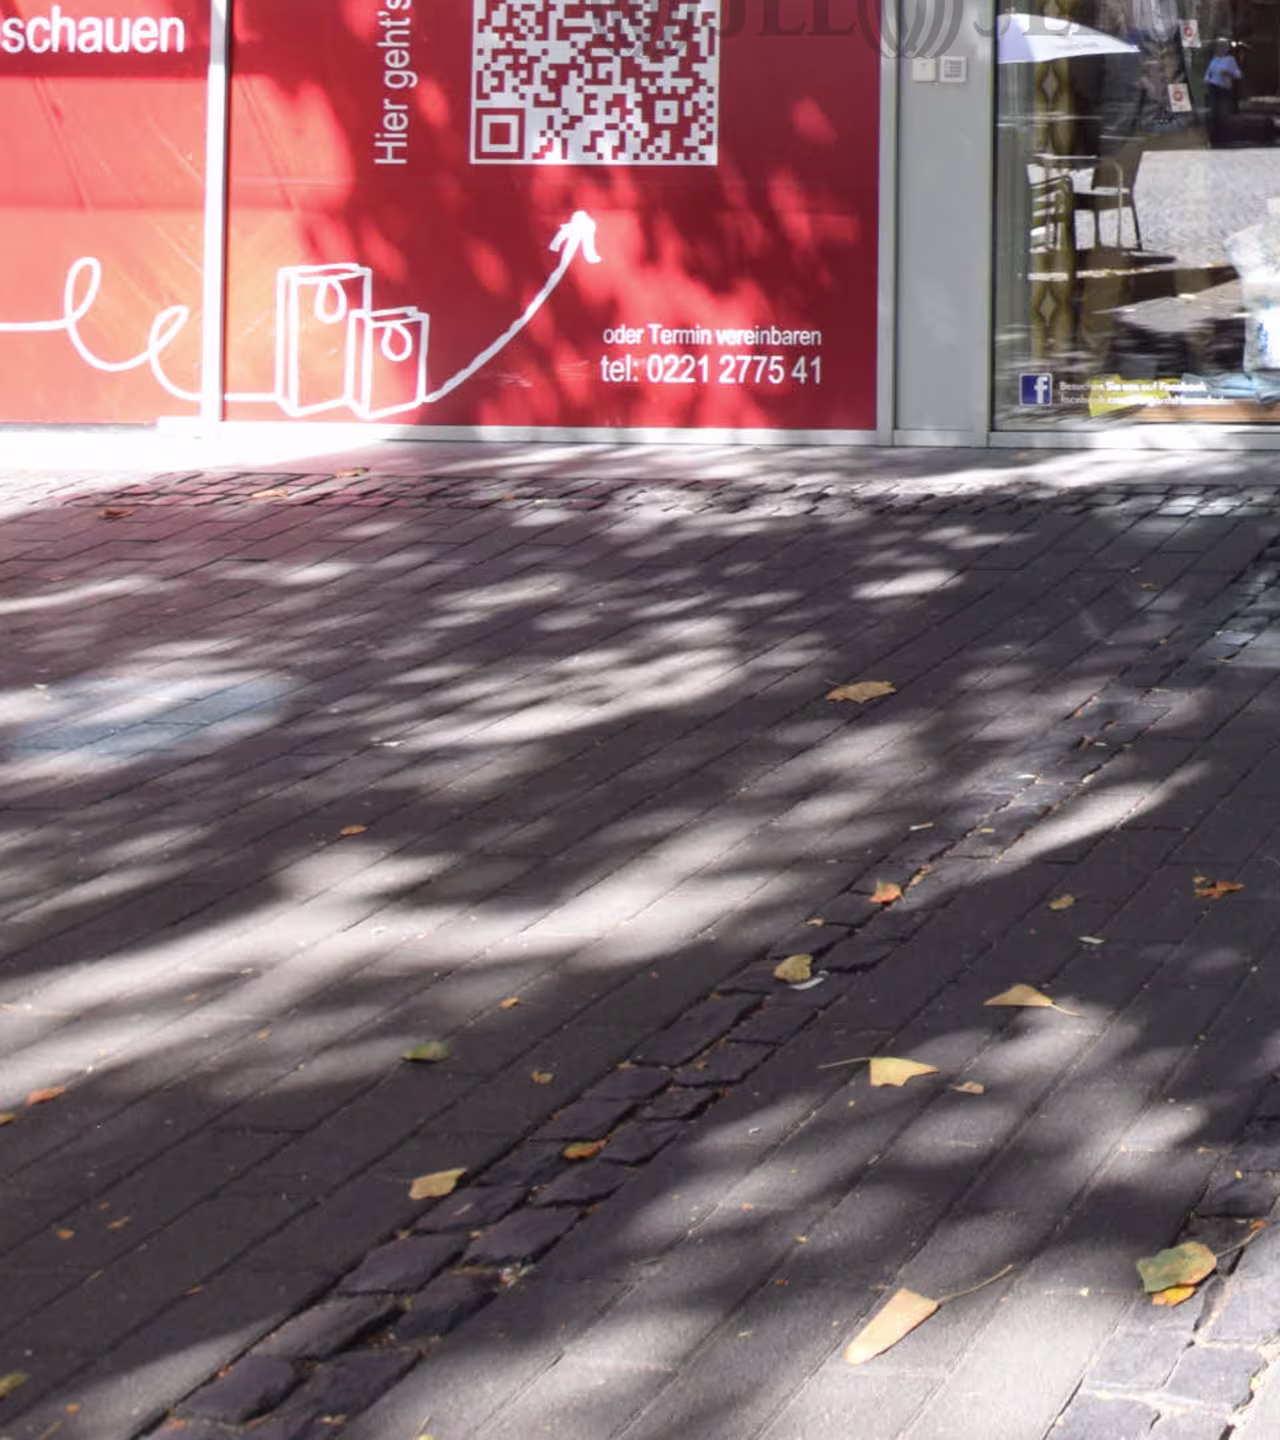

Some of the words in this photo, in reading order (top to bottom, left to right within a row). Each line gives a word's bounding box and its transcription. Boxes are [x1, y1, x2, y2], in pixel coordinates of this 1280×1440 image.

[0, 5, 186, 54] schauen
[373, 98, 409, 165] Hier
[602, 324, 645, 345] oder
[647, 323, 712, 346] Termin
[714, 325, 822, 347] vereinbaren
[600, 353, 639, 383] tel:
[647, 354, 710, 384] 0221
[718, 355, 784, 385] 2775
[790, 355, 822, 385] 41
